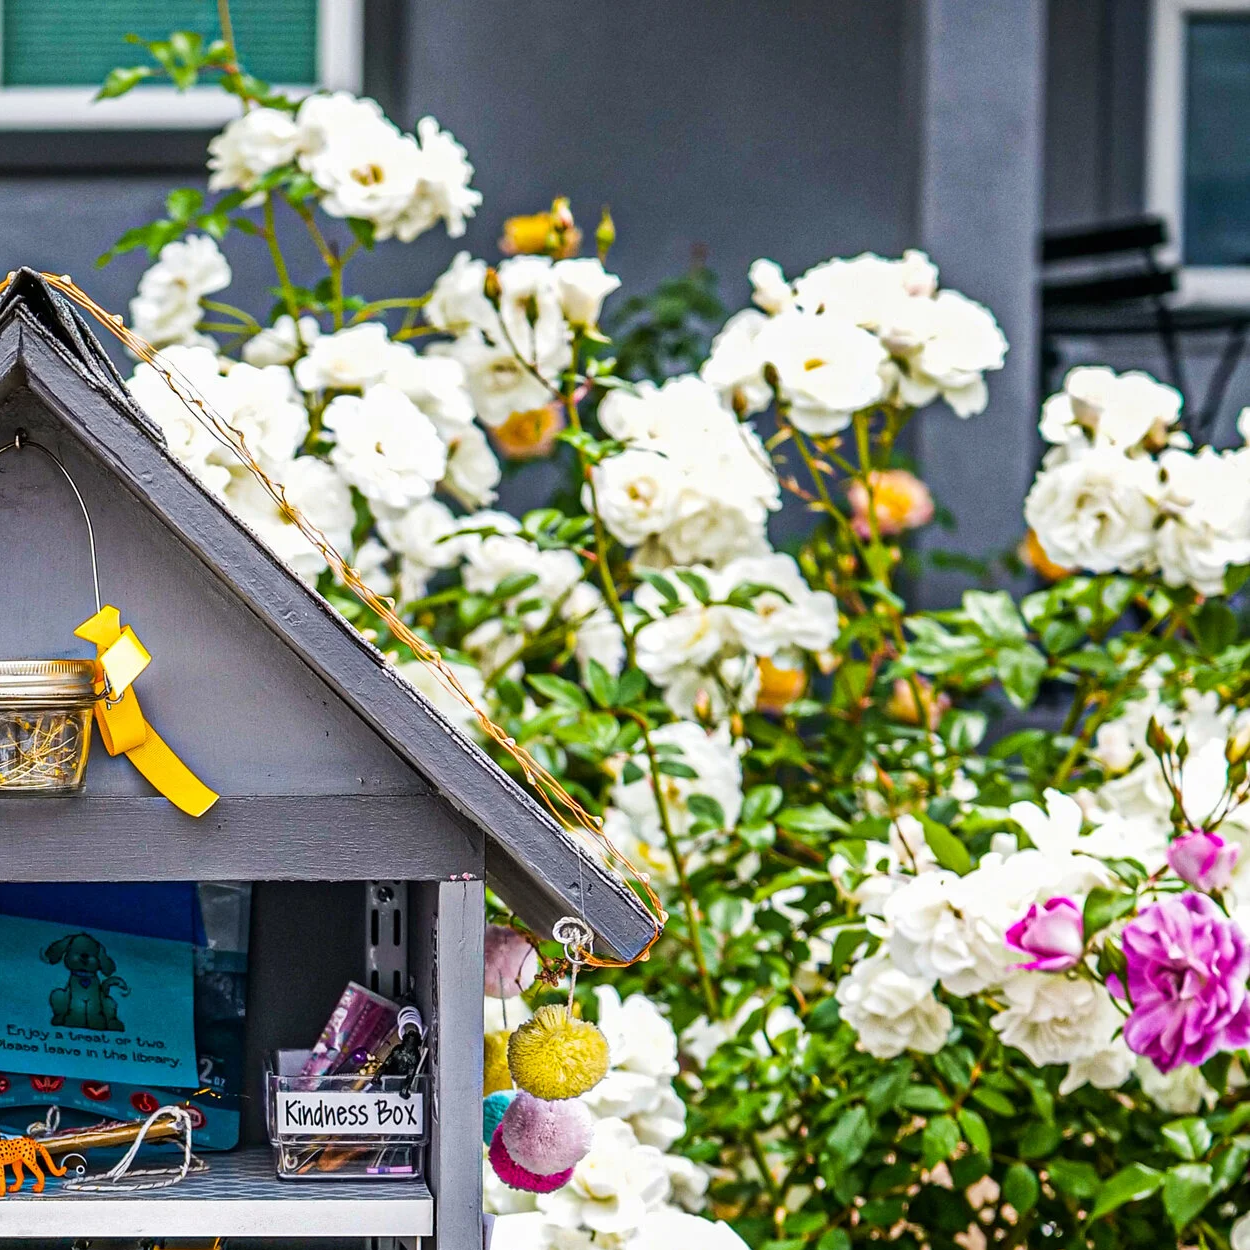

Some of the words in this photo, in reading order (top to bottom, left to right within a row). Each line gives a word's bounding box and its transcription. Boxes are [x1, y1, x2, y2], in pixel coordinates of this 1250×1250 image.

[6, 1024, 49, 1040] Enjoy
[55, 1031, 64, 1040] a
[69, 1032, 110, 1044] treat
[115, 1037, 131, 1046] or
[44, 1042, 81, 1057] leave
[86, 1047, 99, 1059] in
[103, 1049, 128, 1061] the
[133, 1052, 183, 1068] library.
[284, 1099, 368, 1128] Kindness
[376, 1099, 417, 1126] Box
